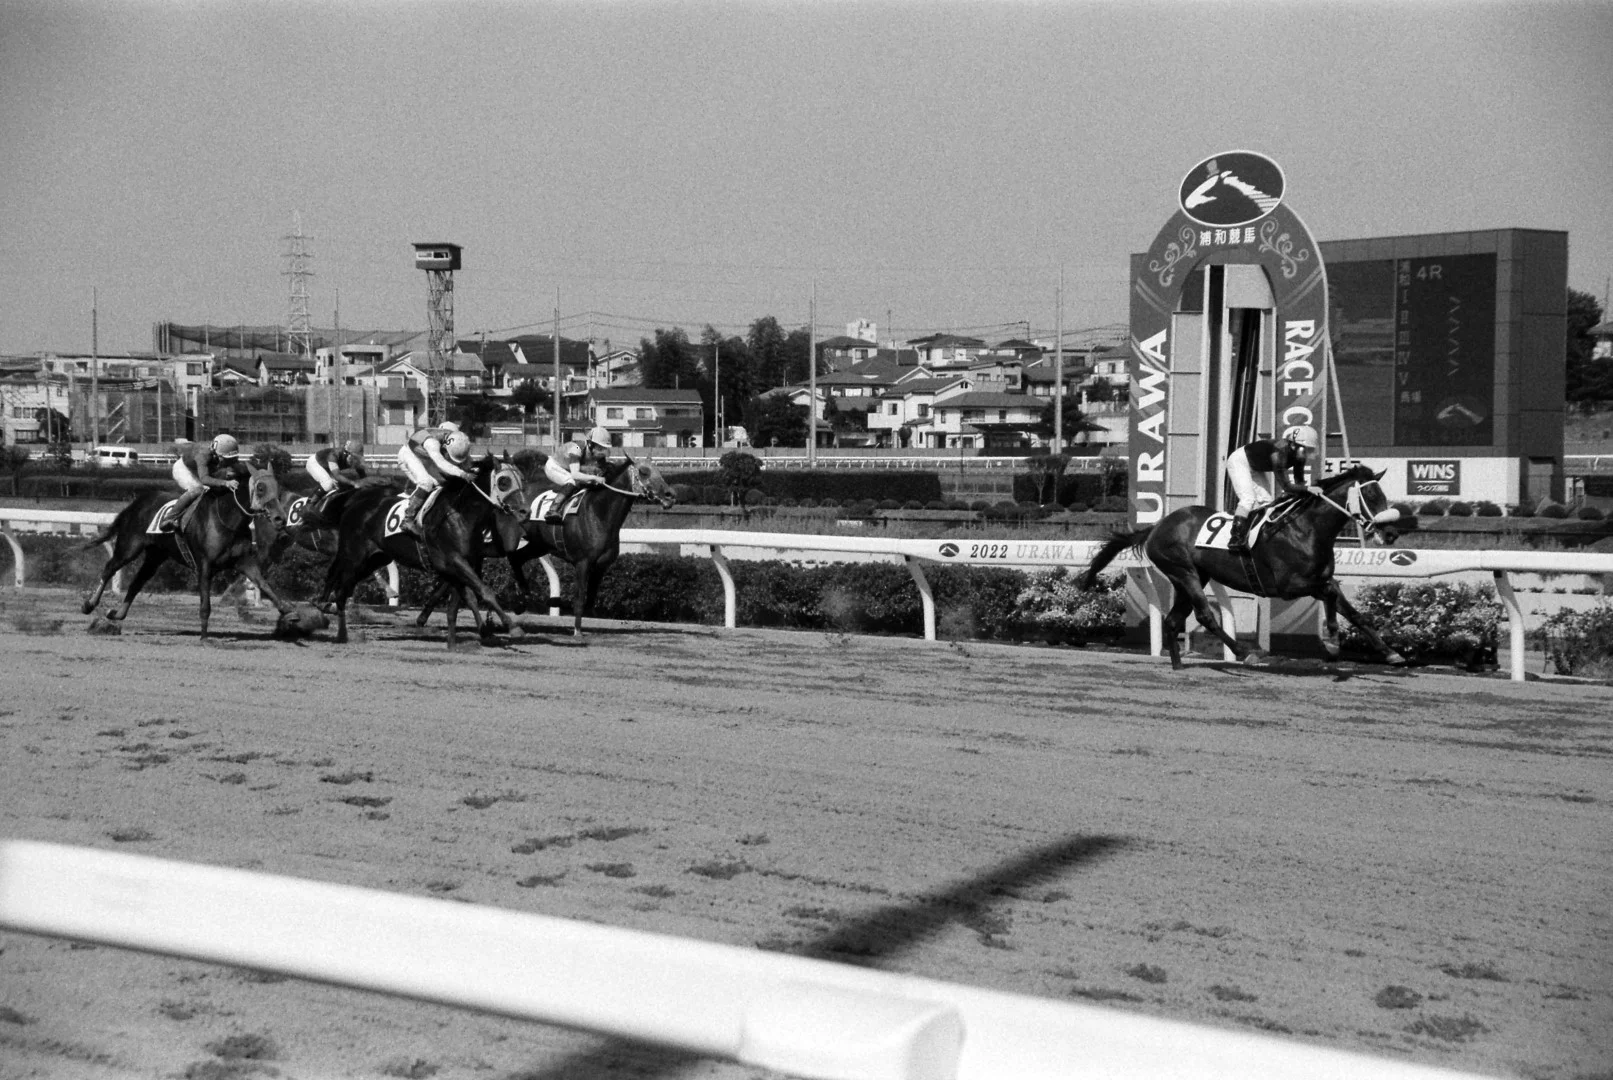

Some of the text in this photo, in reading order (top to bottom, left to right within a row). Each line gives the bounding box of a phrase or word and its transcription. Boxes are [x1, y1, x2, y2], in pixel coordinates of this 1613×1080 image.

[1199, 227, 1256, 246] 浦和競馬
[1416, 264, 1443, 281] 4R
[1283, 319, 1315, 397] RACE
[1135, 328, 1168, 524] URAWA
[1412, 464, 1456, 479] WINS
[289, 501, 304, 524] 8
[386, 504, 402, 533] 6
[1205, 516, 1227, 545] 9
[970, 544, 1009, 558] 2022
[1016, 544, 1076, 560] URAWA
